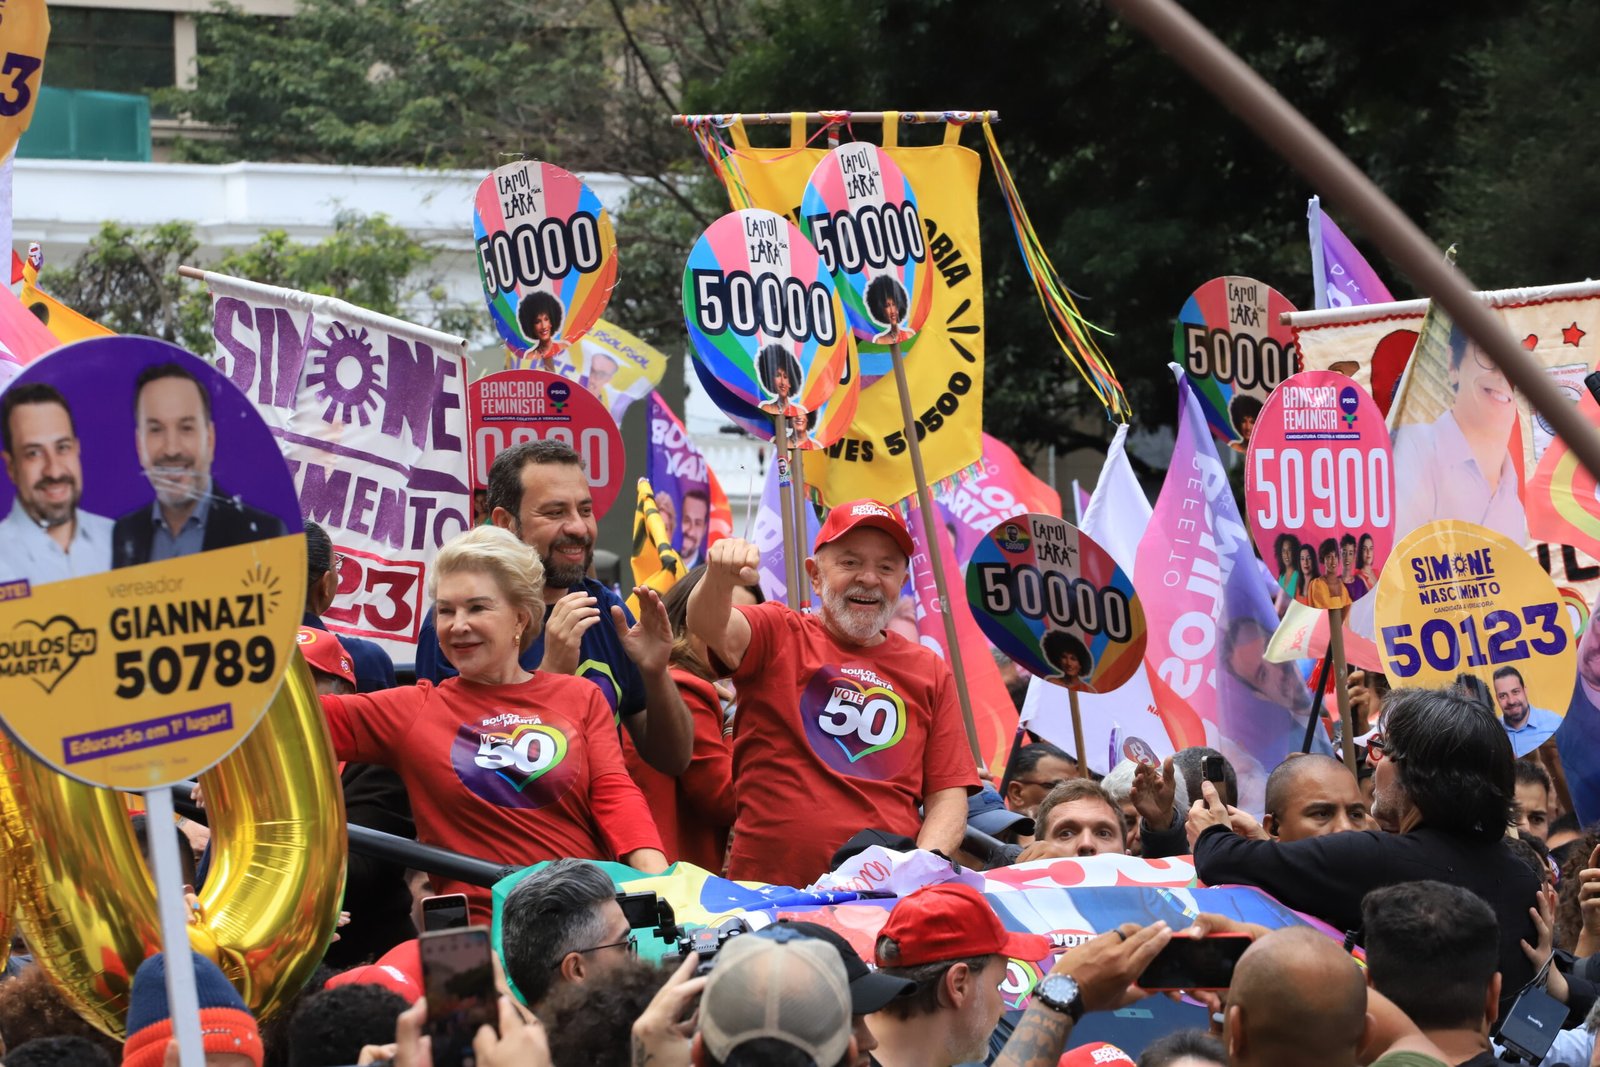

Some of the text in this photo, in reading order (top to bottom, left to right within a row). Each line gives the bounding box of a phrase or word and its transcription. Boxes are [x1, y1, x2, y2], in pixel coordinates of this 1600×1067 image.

[476, 213, 600, 297] 50000
[808, 201, 926, 277] 50000
[694, 271, 837, 345] 50000
[480, 381, 545, 398] BANCADA
[481, 399, 546, 414] FEMINISTA
[1282, 386, 1337, 409] BANCADA
[884, 371, 972, 456] 50500
[1283, 409, 1338, 430] FEMINISTA
[1254, 446, 1391, 530] 50900
[1411, 548, 1495, 583] SIMONE
[106, 576, 185, 598] vereador
[979, 562, 1132, 643] 50000
[1419, 582, 1501, 606] NASCIMENTO
[110, 593, 265, 641] GIANNAZI
[1433, 605, 1462, 614] CANDIDATA
[1381, 602, 1567, 678] 50123
[115, 635, 276, 699] 50789
[840, 668, 876, 677] BOULOS
[861, 675, 894, 691] MARTA
[834, 688, 864, 704] VOTE
[69, 728, 144, 757] Educação
[145, 724, 169, 740] em
[186, 709, 228, 732] lugar!
[482, 713, 520, 726] BOULOS
[819, 688, 897, 745] 50
[475, 732, 555, 773] 50
